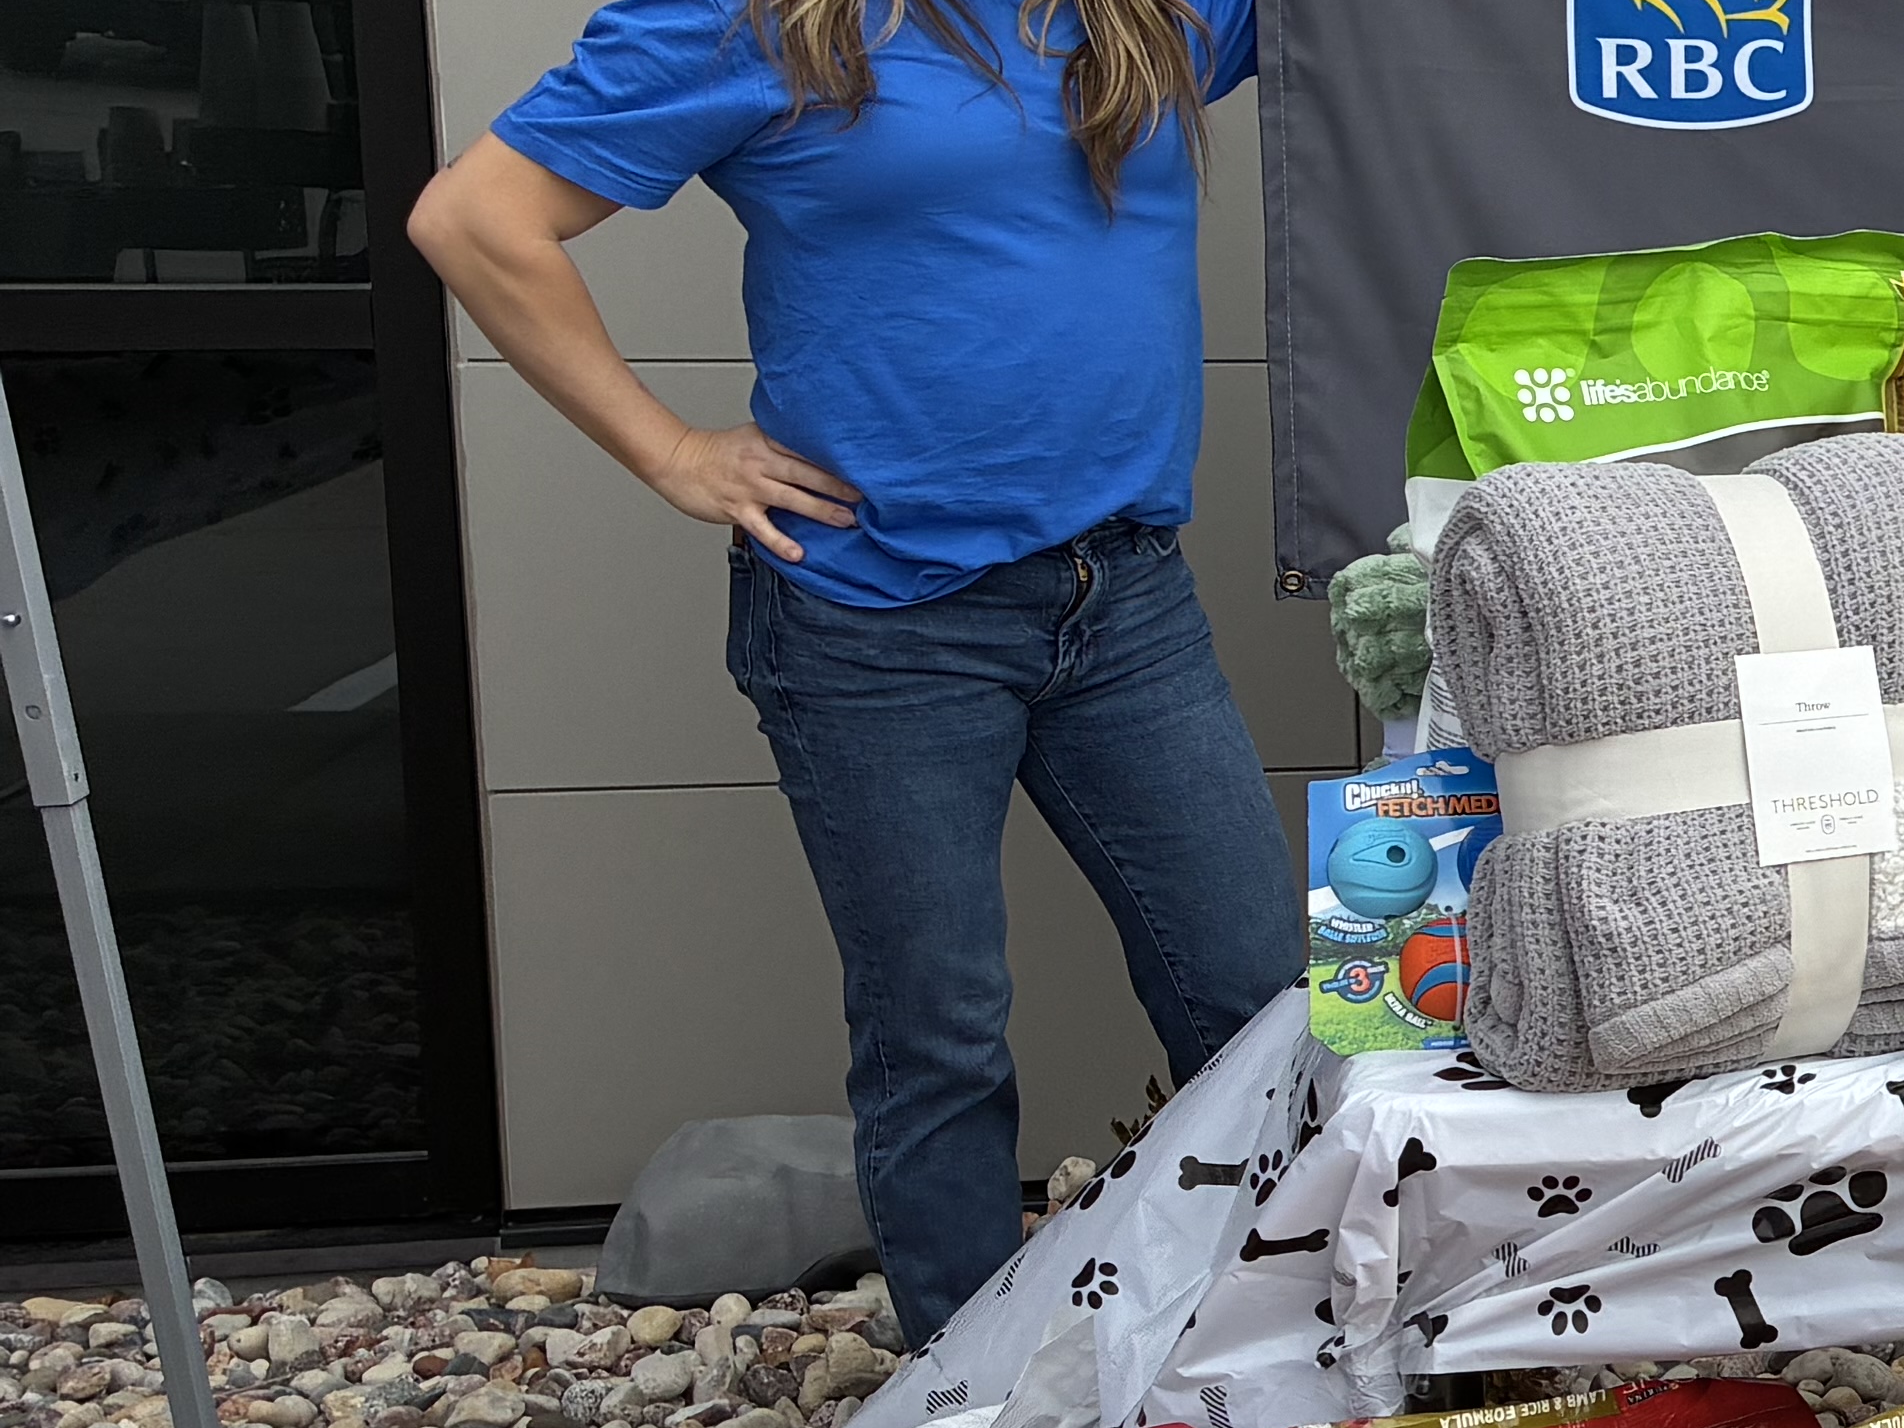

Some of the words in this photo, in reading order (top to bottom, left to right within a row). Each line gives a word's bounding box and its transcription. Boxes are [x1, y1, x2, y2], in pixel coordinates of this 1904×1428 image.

[1598, 38, 1789, 102] RBC
[1795, 700, 1831, 712] Throw
[1771, 789, 1880, 813] THRESHOLD
